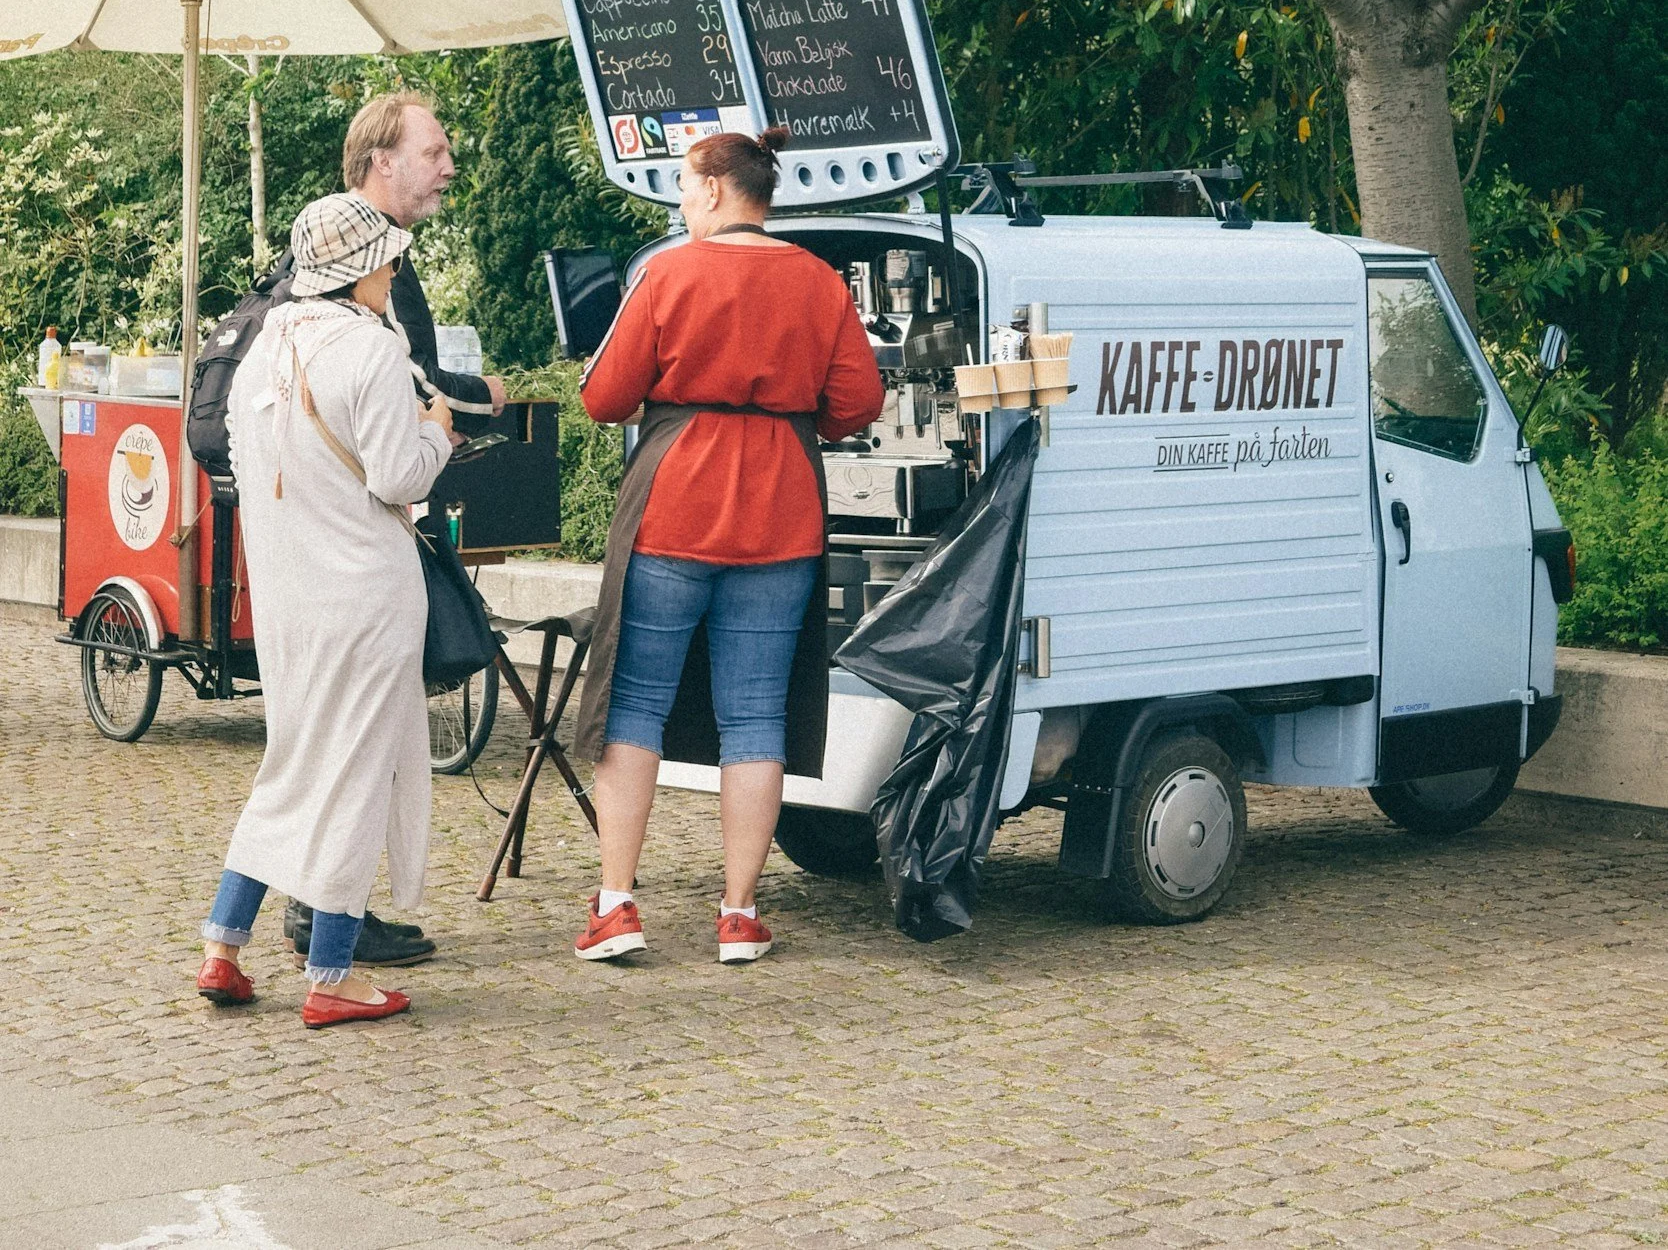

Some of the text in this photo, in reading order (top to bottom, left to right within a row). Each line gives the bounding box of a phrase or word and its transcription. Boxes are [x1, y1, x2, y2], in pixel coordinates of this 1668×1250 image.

[591, 18, 677, 43] Americano
[695, 4, 722, 32] 35
[746, 0, 804, 31] Matcha
[595, 34, 732, 84] Espresso 29
[756, 36, 853, 70] Varm Belgisk
[607, 69, 739, 111] Cortado 34
[765, 56, 912, 98] Chokolade 46
[702, 125, 720, 136] VISA
[890, 99, 920, 132] +4
[1096, 338, 1344, 416] KAFFE DRØNET
[1157, 426, 1332, 472] DIN KAFFE på farten
[124, 516, 148, 542] bike
